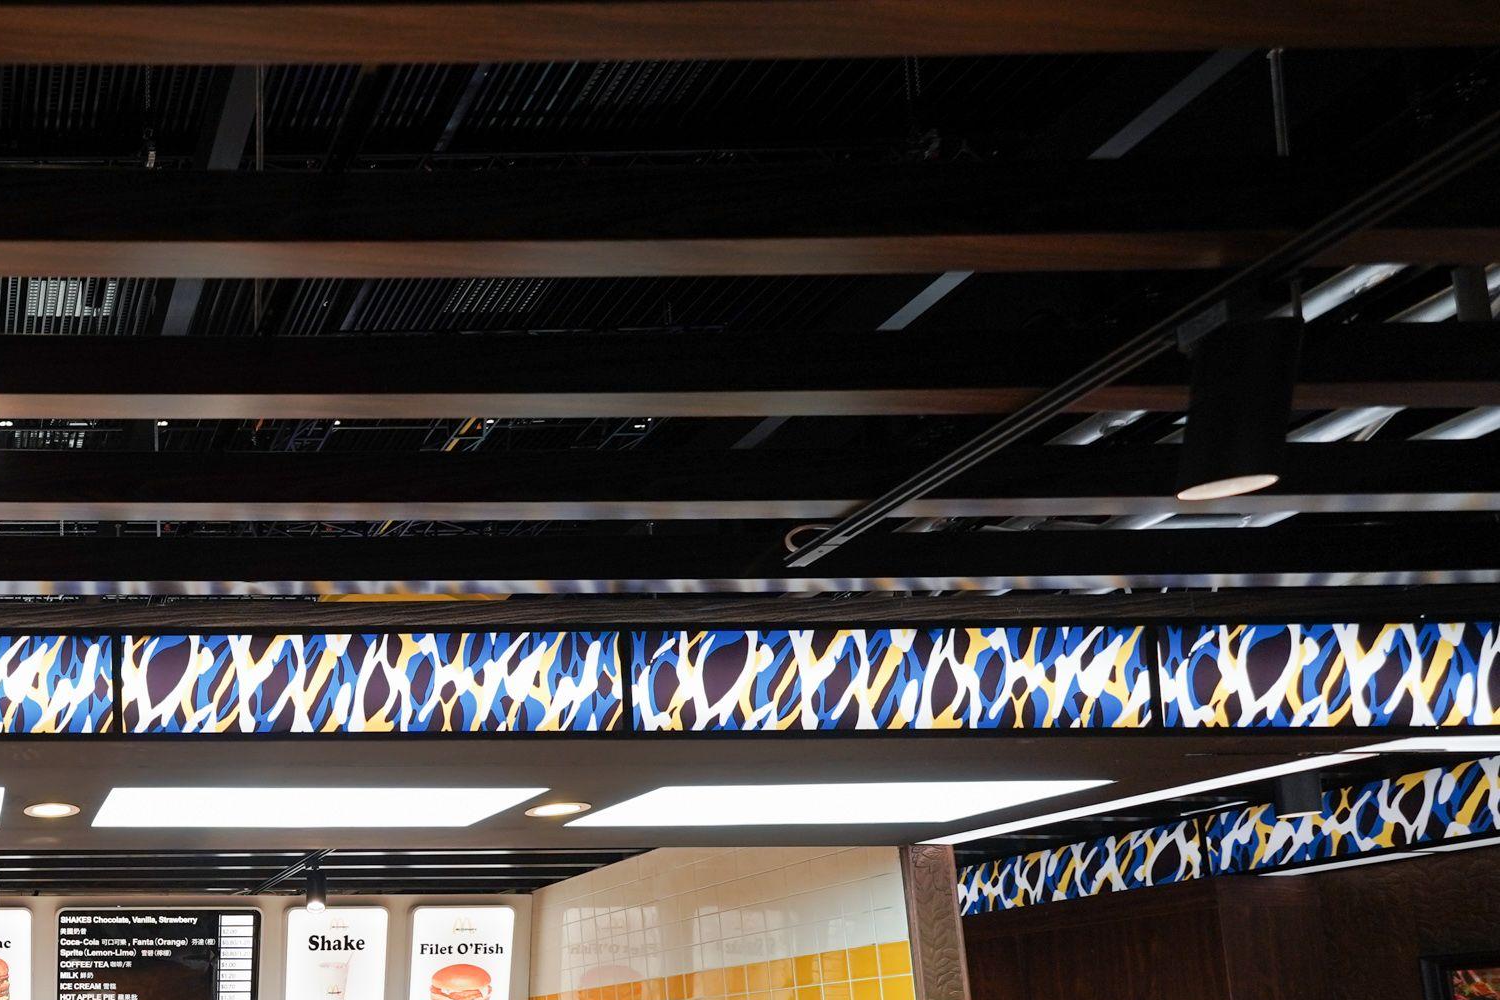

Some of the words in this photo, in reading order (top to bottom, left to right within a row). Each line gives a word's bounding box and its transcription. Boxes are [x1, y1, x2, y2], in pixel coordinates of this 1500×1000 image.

[60, 916, 92, 924] SHAKES
[93, 916, 131, 925] Chocolate,
[132, 916, 157, 925] Vanilla,
[158, 916, 198, 925] Strawberry
[60, 938, 100, 946] Coca-Cola
[308, 935, 366, 952] Shake
[420, 943, 453, 955] Filet
[457, 943, 504, 955] O'Fish
